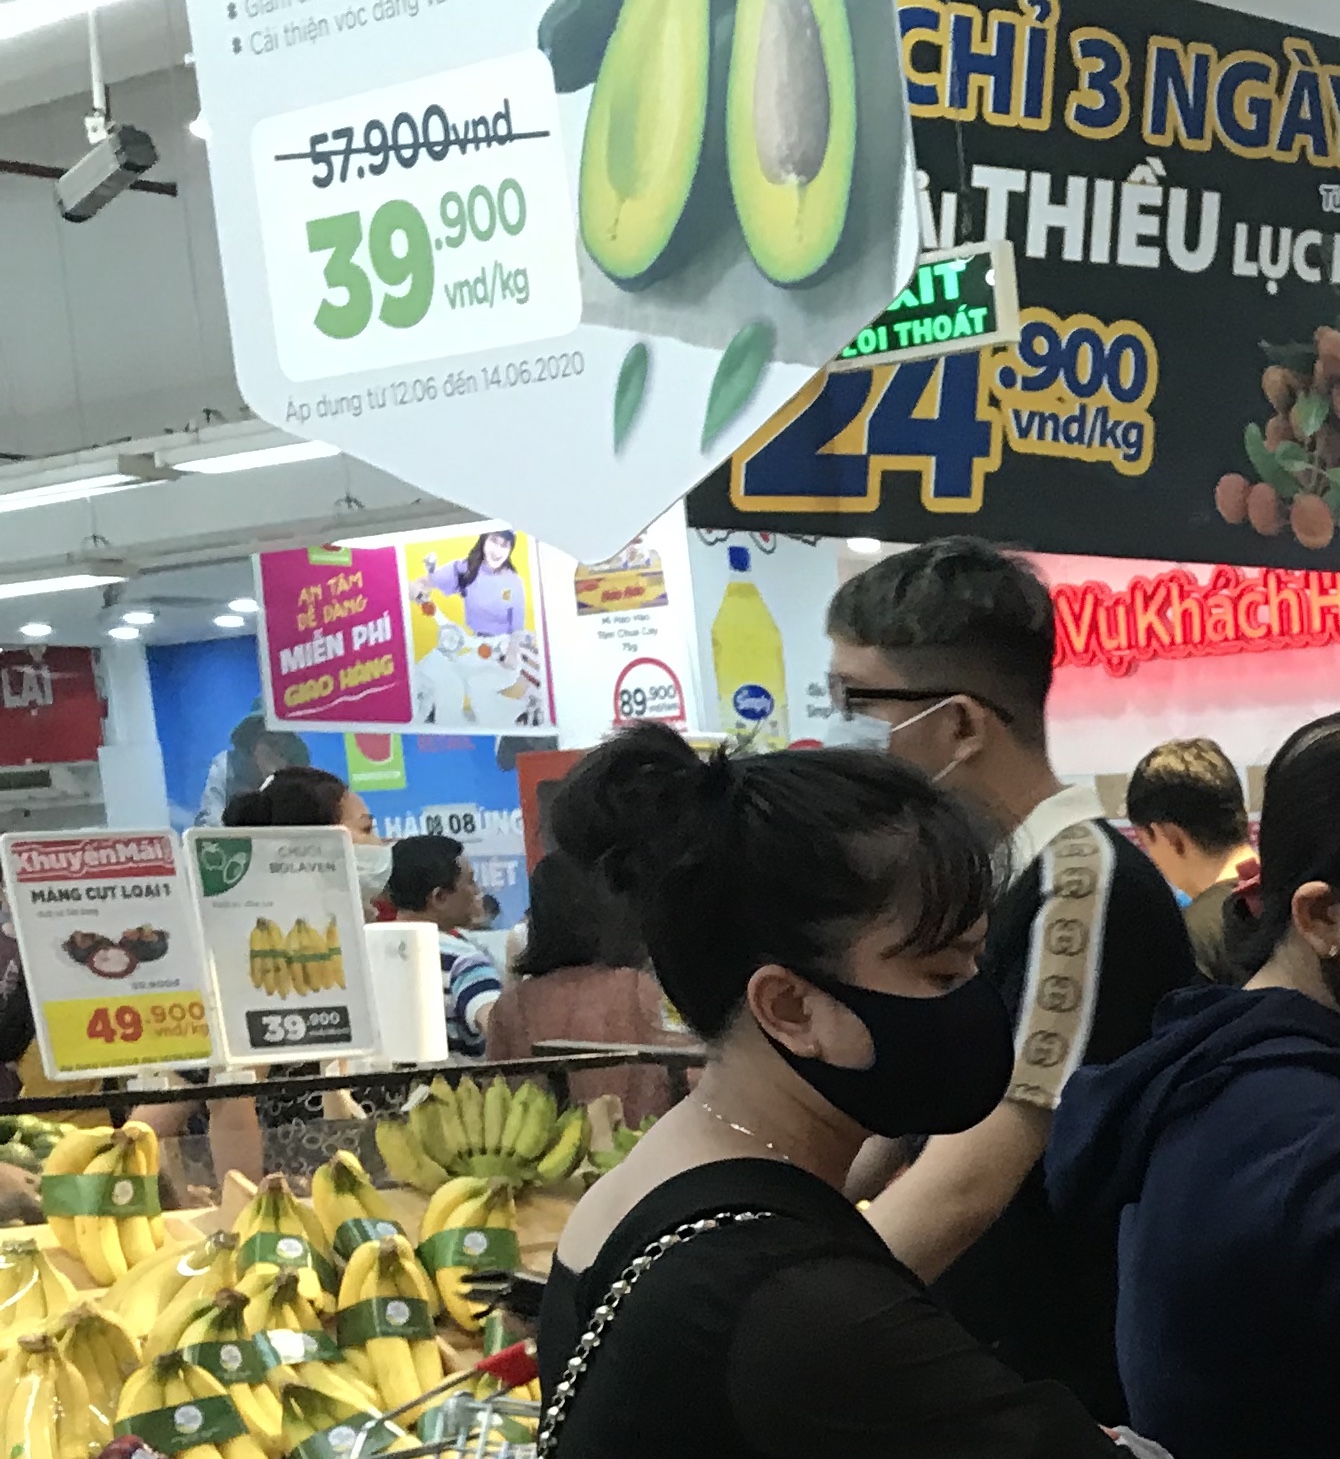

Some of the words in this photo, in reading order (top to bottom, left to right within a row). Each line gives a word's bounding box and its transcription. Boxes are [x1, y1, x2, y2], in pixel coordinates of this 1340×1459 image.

[284, 17, 329, 46] thiện
[1064, 26, 1131, 140] 3
[972, 156, 1220, 276] THIỀU
[444, 260, 530, 309] vnd/kg
[1233, 222, 1325, 296] LỤC
[894, 304, 988, 346] THOÁT
[481, 351, 585, 390] 14.06.2020
[1010, 402, 1153, 474] vnd/kg
[280, 628, 345, 675] MIỄN
[351, 610, 392, 651] PHÍ
[284, 674, 334, 707] GIAO
